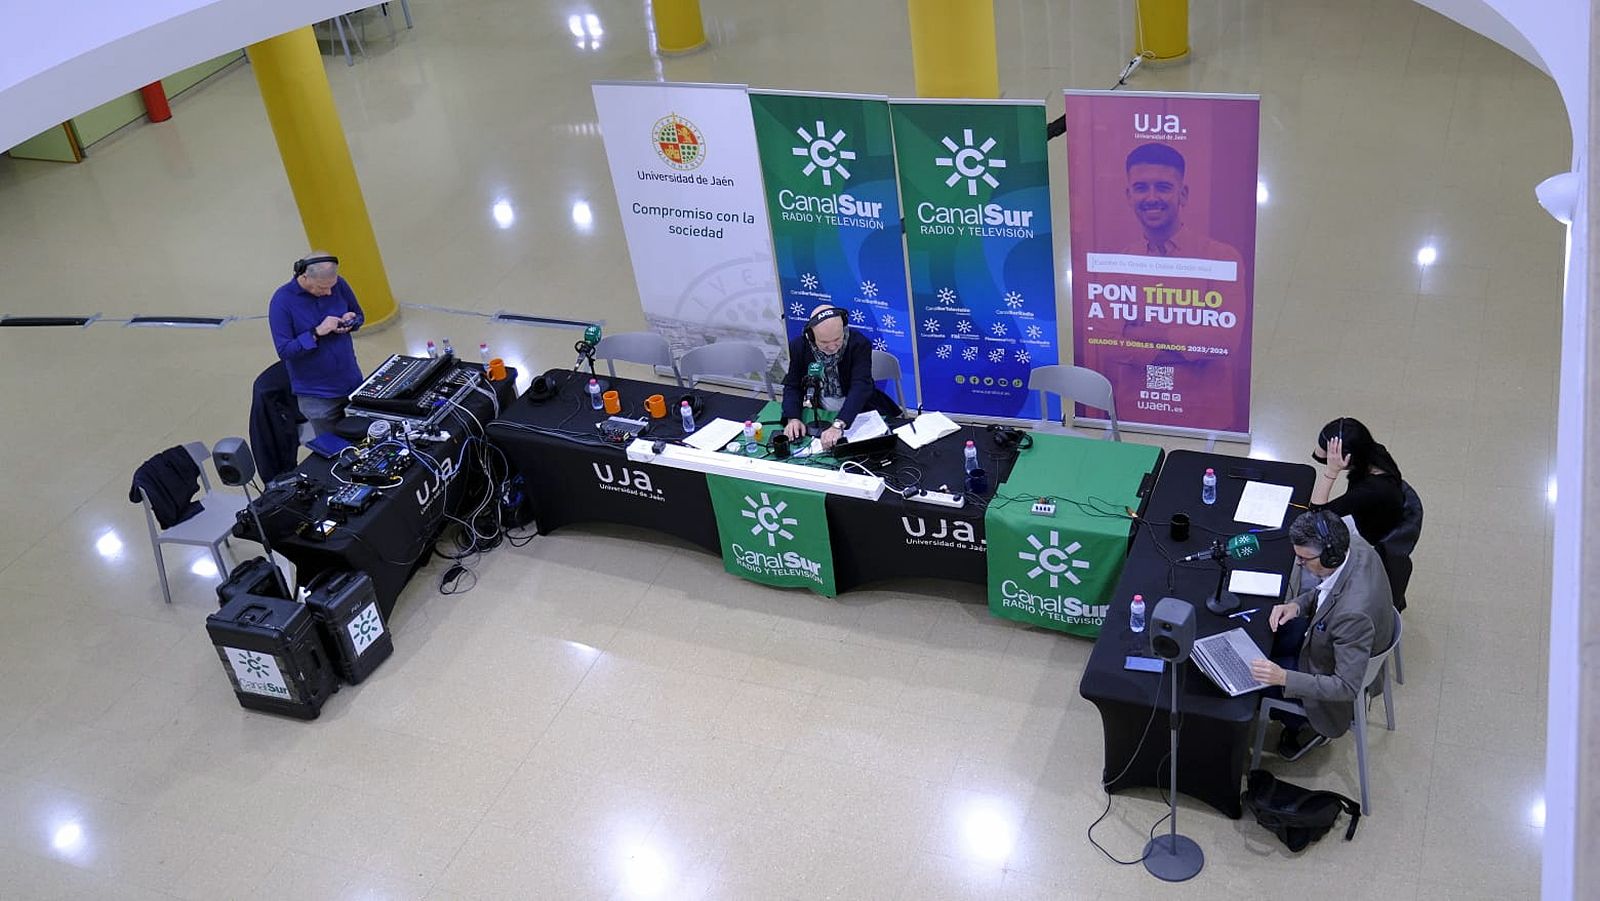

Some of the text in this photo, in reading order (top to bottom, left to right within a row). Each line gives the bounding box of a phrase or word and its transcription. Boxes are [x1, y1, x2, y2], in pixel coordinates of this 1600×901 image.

[637, 171, 735, 187] Universidad de Jaén
[632, 202, 755, 224] Compromiso con la
[779, 189, 882, 219] CanalSur
[917, 202, 1034, 227] CanalSur
[669, 223, 724, 239] sociedad
[782, 211, 885, 230] RADIO Y TELEVISIÓN
[920, 225, 1034, 239] RADIO Y TELEVISIÓN
[1088, 283, 1223, 308] PON TÍTULO
[1088, 302, 1237, 329] A TU FUTURO
[1088, 337, 1118, 346] GRADOS
[1126, 340, 1155, 349] DOBLES
[1156, 343, 1187, 352] GRADOS
[1188, 345, 1229, 355] 2023/2024
[599, 483, 638, 497] Universidad
[648, 493, 666, 503] Jaén
[905, 538, 954, 548] Universidad
[731, 543, 822, 575] CanalSur
[736, 558, 762, 574] RADIO
[1001, 579, 1110, 618] CanalSur
[1002, 598, 1106, 626] RADIO Y TELEVISIÓ
